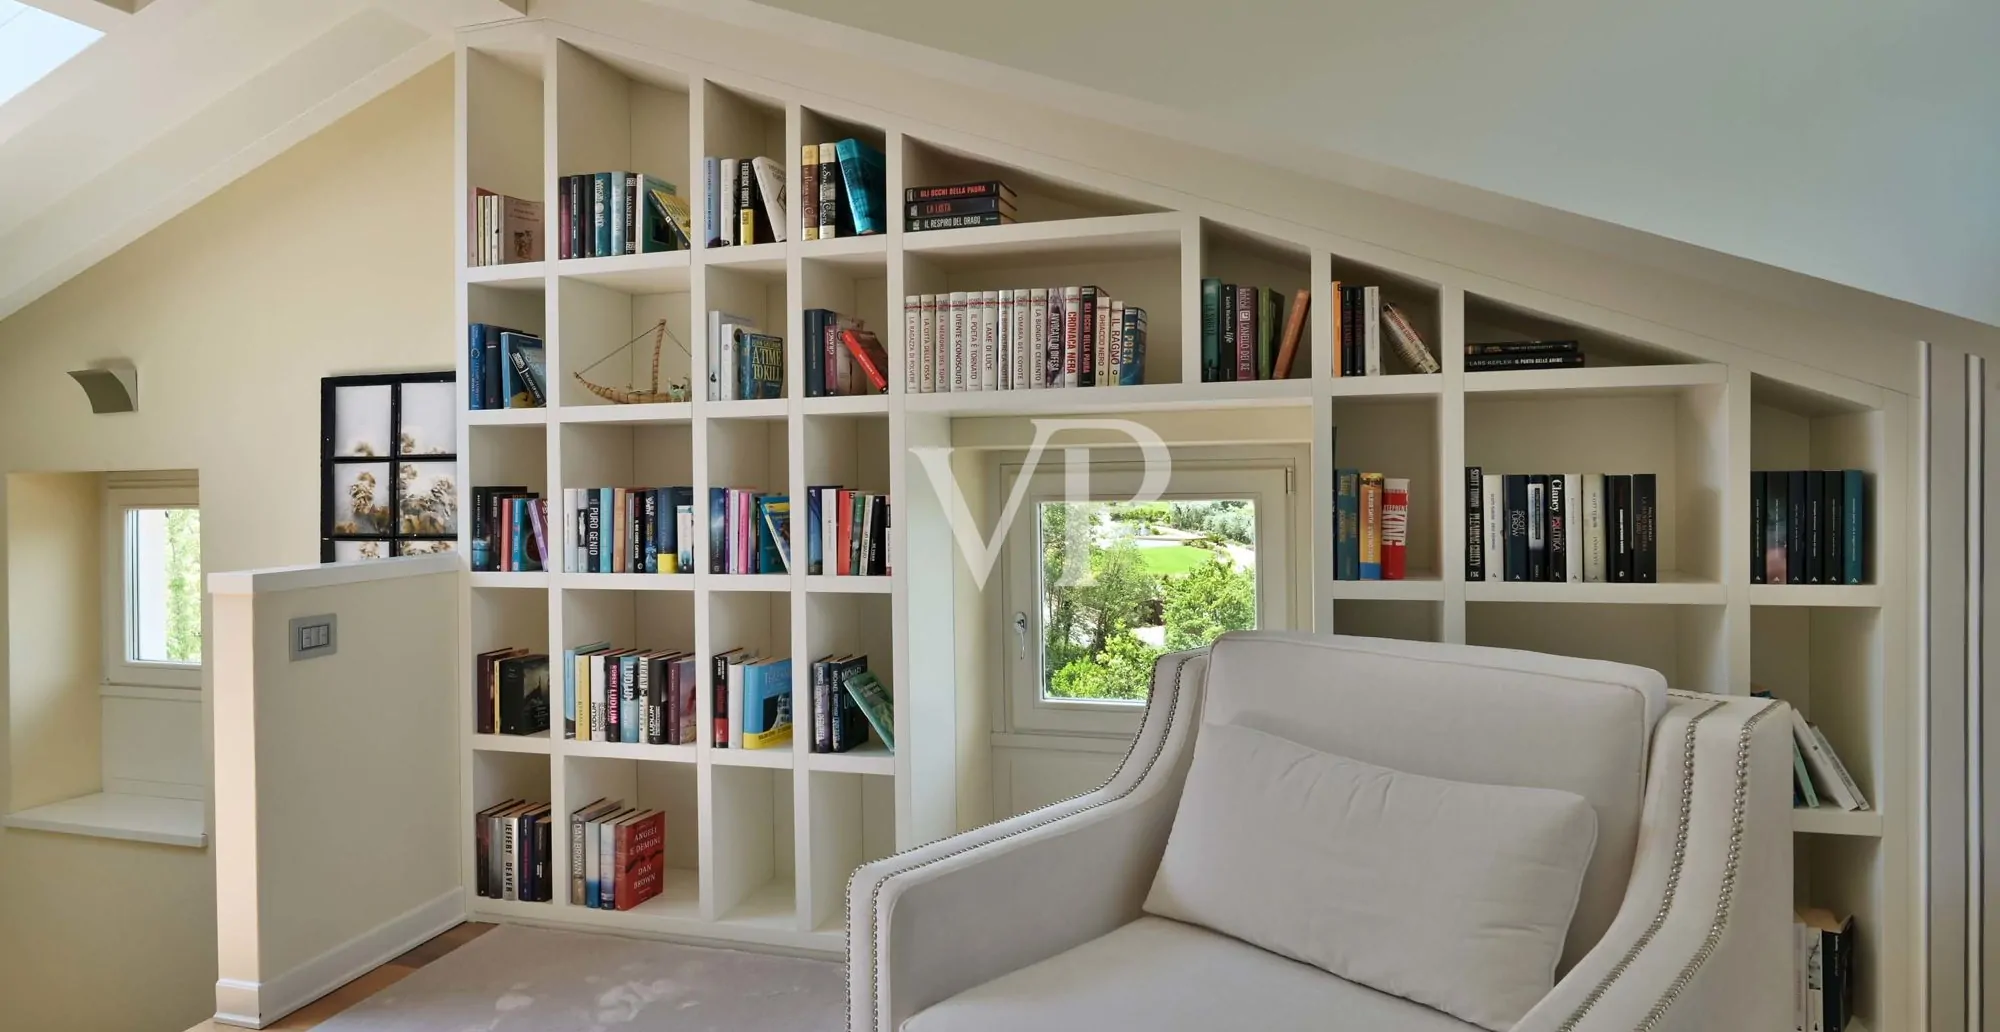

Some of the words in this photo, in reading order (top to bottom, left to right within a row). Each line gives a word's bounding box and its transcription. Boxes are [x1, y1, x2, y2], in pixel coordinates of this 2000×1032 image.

[931, 218, 951, 228] RESPIRO
[953, 217, 962, 226] DEL
[1067, 312, 1076, 349] CRONACA
[1111, 318, 1120, 326] IL
[1125, 322, 1135, 331] IL
[1224, 332, 1234, 343] life
[752, 346, 760, 364] A
[760, 348, 781, 366] TIME
[1111, 330, 1120, 365] RAGNO
[1123, 335, 1134, 364] POETA
[763, 364, 780, 381] KILL
[1067, 352, 1076, 374] NERA
[1470, 468, 1479, 486] SCOTT
[1549, 479, 1561, 512] Clancy
[590, 508, 598, 528] PURO
[1382, 511, 1406, 546] KING
[590, 532, 598, 555] GENIO
[574, 824, 582, 840] DAN
[634, 827, 657, 841] ANGELI
[574, 843, 582, 874] BROWN
[638, 864, 652, 875] DAN
[633, 873, 656, 889] BROWN
